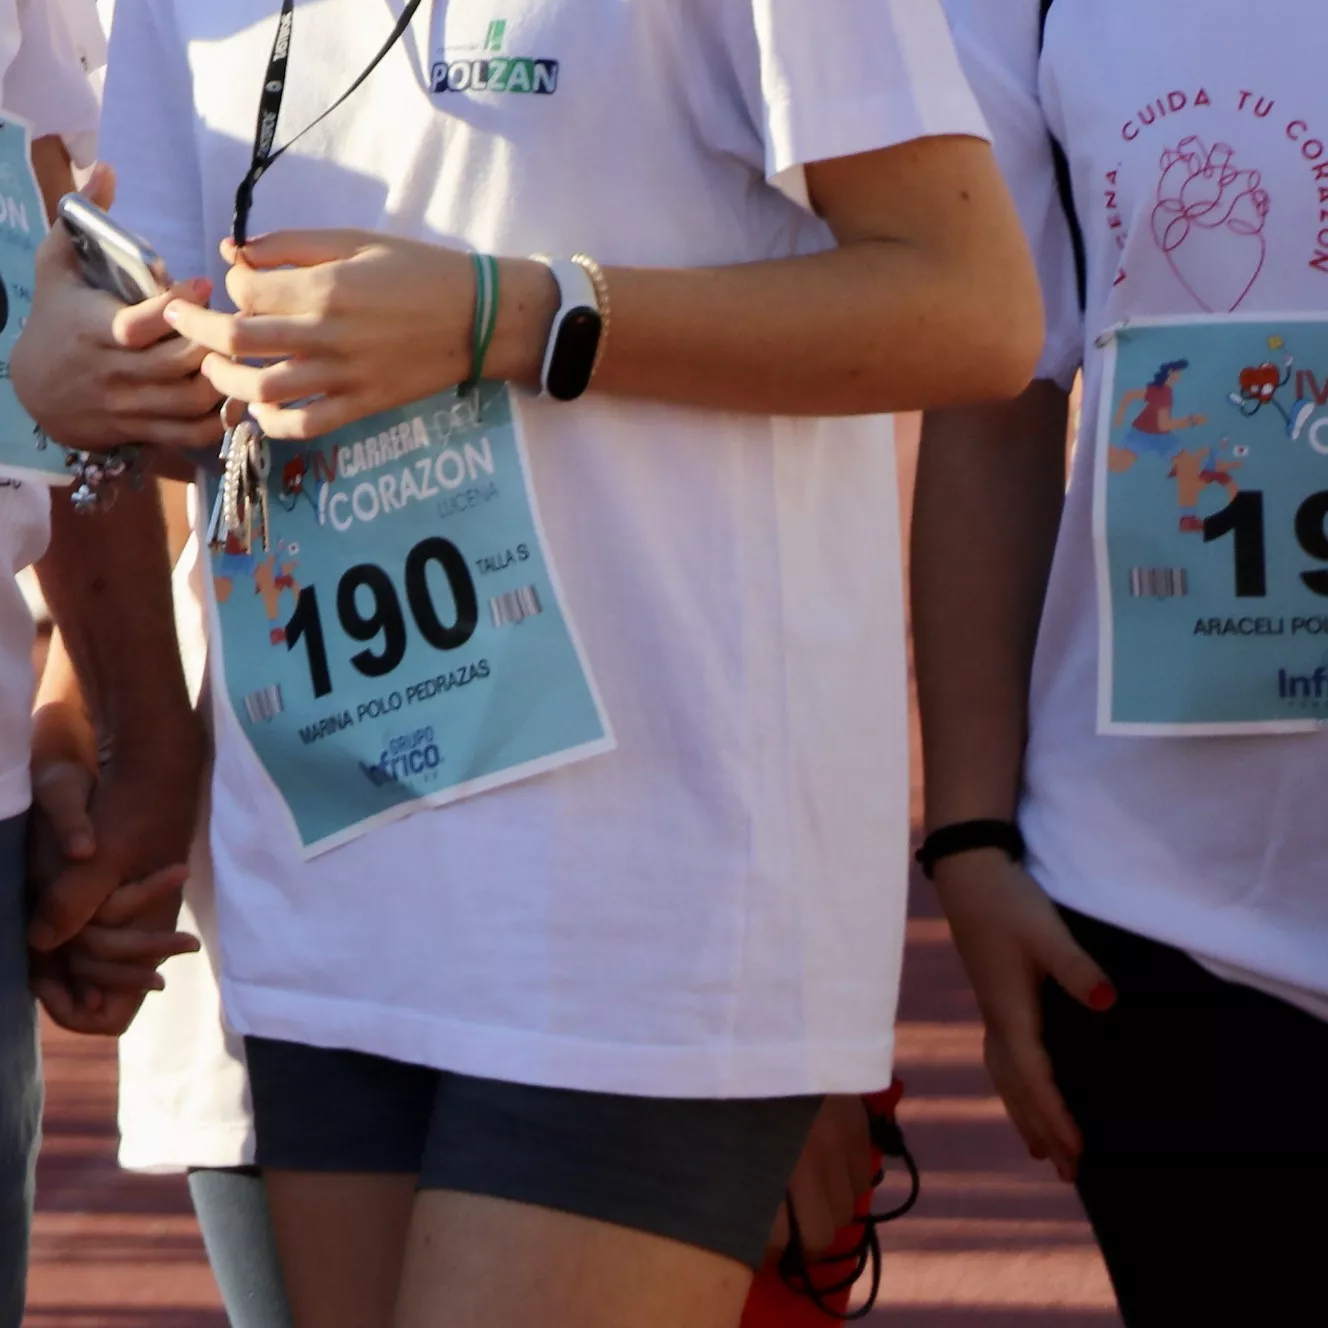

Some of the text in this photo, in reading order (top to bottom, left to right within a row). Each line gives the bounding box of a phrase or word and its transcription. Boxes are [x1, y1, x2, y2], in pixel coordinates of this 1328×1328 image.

[429, 57, 559, 95] POLZAN
[1121, 87, 1211, 142] CUIDA
[1236, 89, 1275, 118] TU
[338, 417, 429, 477] CARRERA
[516, 543, 530, 561] S
[286, 535, 479, 700] 190
[1194, 617, 1283, 637] ARACELI
[298, 658, 491, 745] MARINA POLO PEDRAZAS
[1278, 666, 1328, 699] Inf
[389, 725, 435, 753] GRUPO
